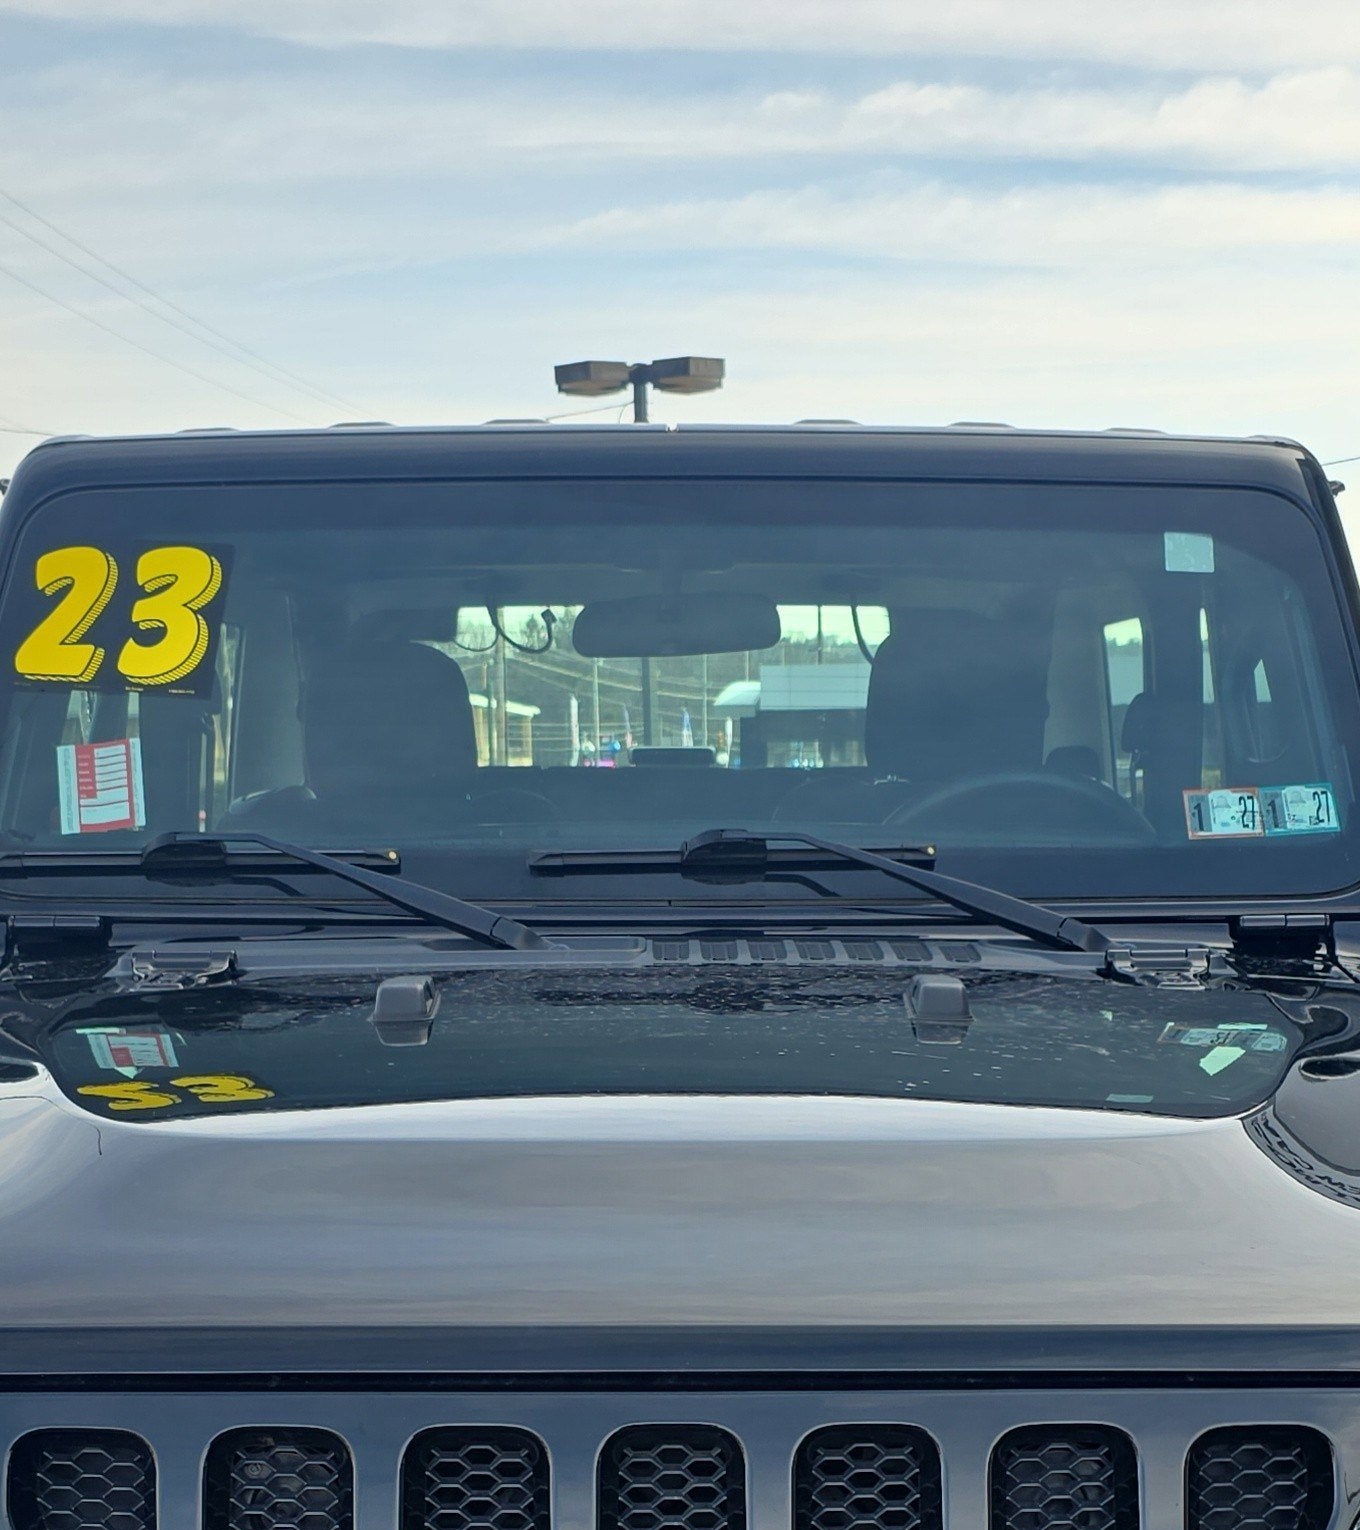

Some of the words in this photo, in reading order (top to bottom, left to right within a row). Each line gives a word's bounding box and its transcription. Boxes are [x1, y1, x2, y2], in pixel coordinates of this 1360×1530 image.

[15, 546, 222, 686] 23
[1194, 802, 1204, 831] 1
[1238, 795, 1256, 830] 27
[1268, 799, 1280, 829] 1
[1312, 790, 1331, 823] 27
